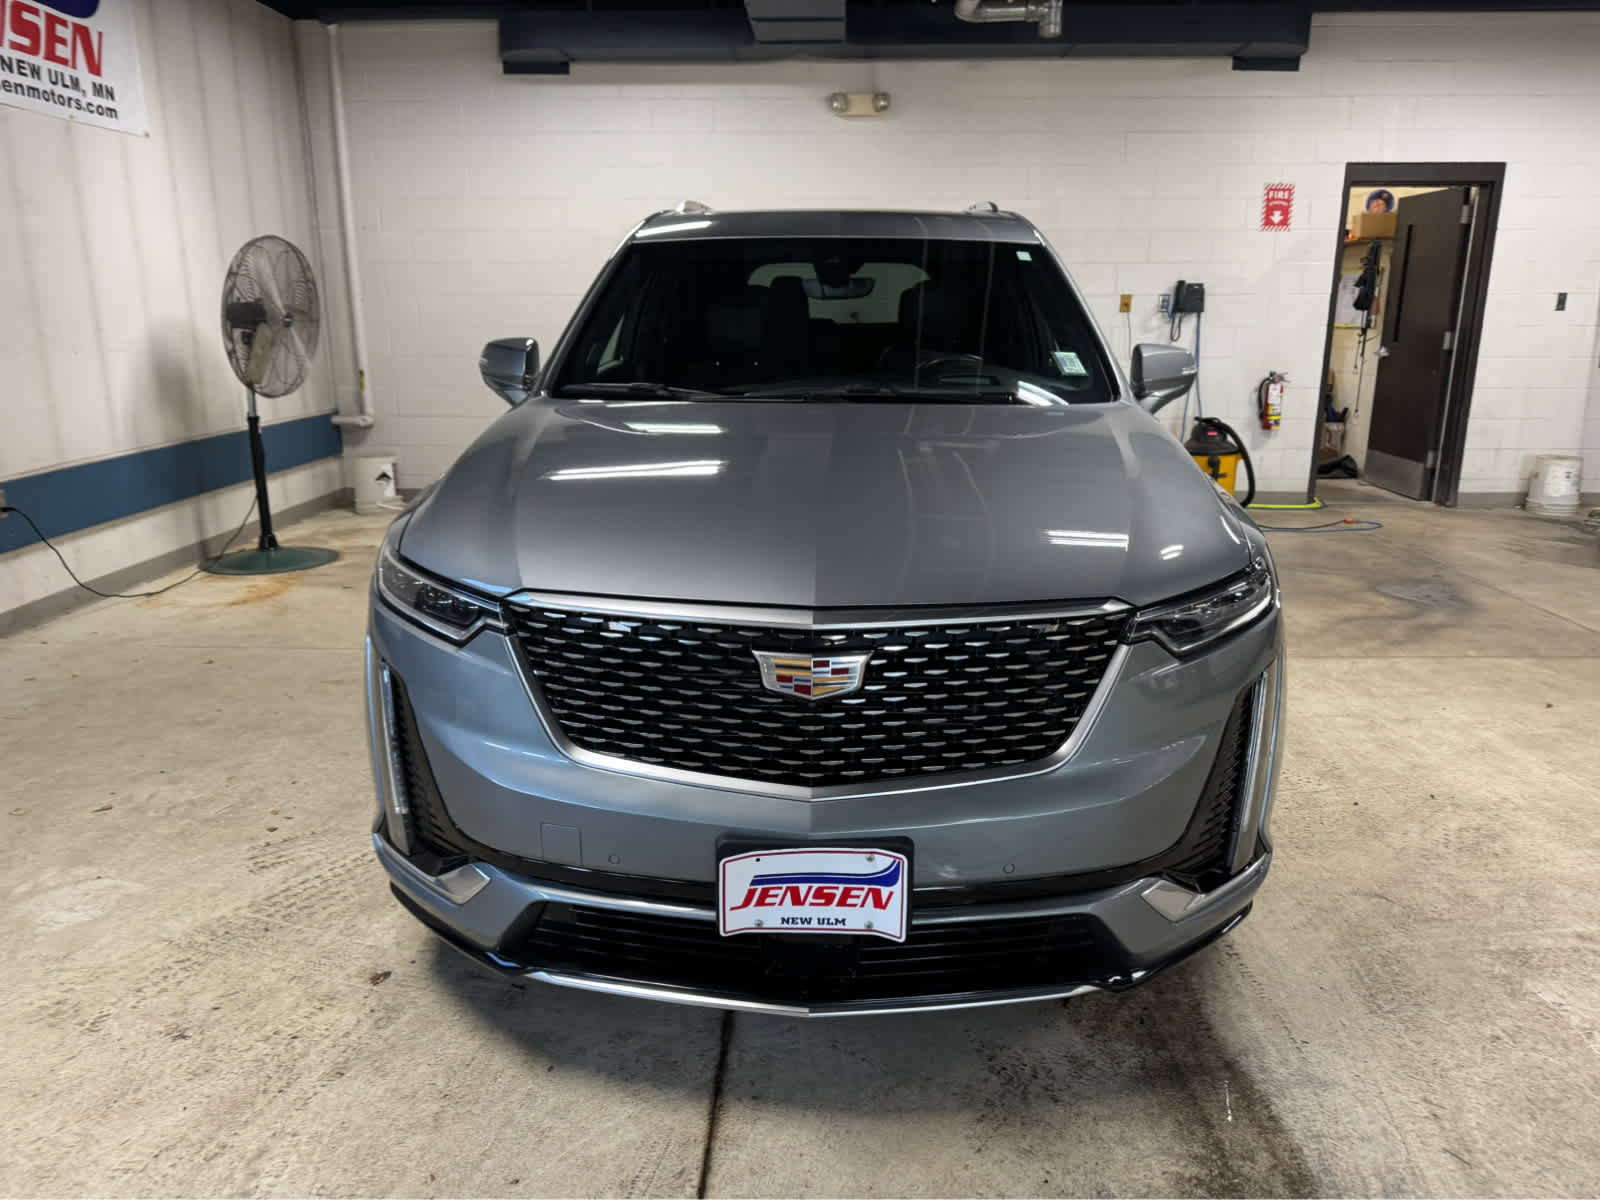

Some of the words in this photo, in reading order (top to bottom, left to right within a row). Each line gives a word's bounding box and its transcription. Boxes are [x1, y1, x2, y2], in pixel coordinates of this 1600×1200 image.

[0, 0, 103, 77] SEN
[0, 54, 42, 81] NEW
[48, 68, 87, 97] ULM,
[92, 81, 115, 101] MN
[0, 79, 119, 120] enmotors.com
[730, 885, 894, 911] JENSEN
[780, 916, 812, 926] NEW
[817, 917, 847, 926] ULM
